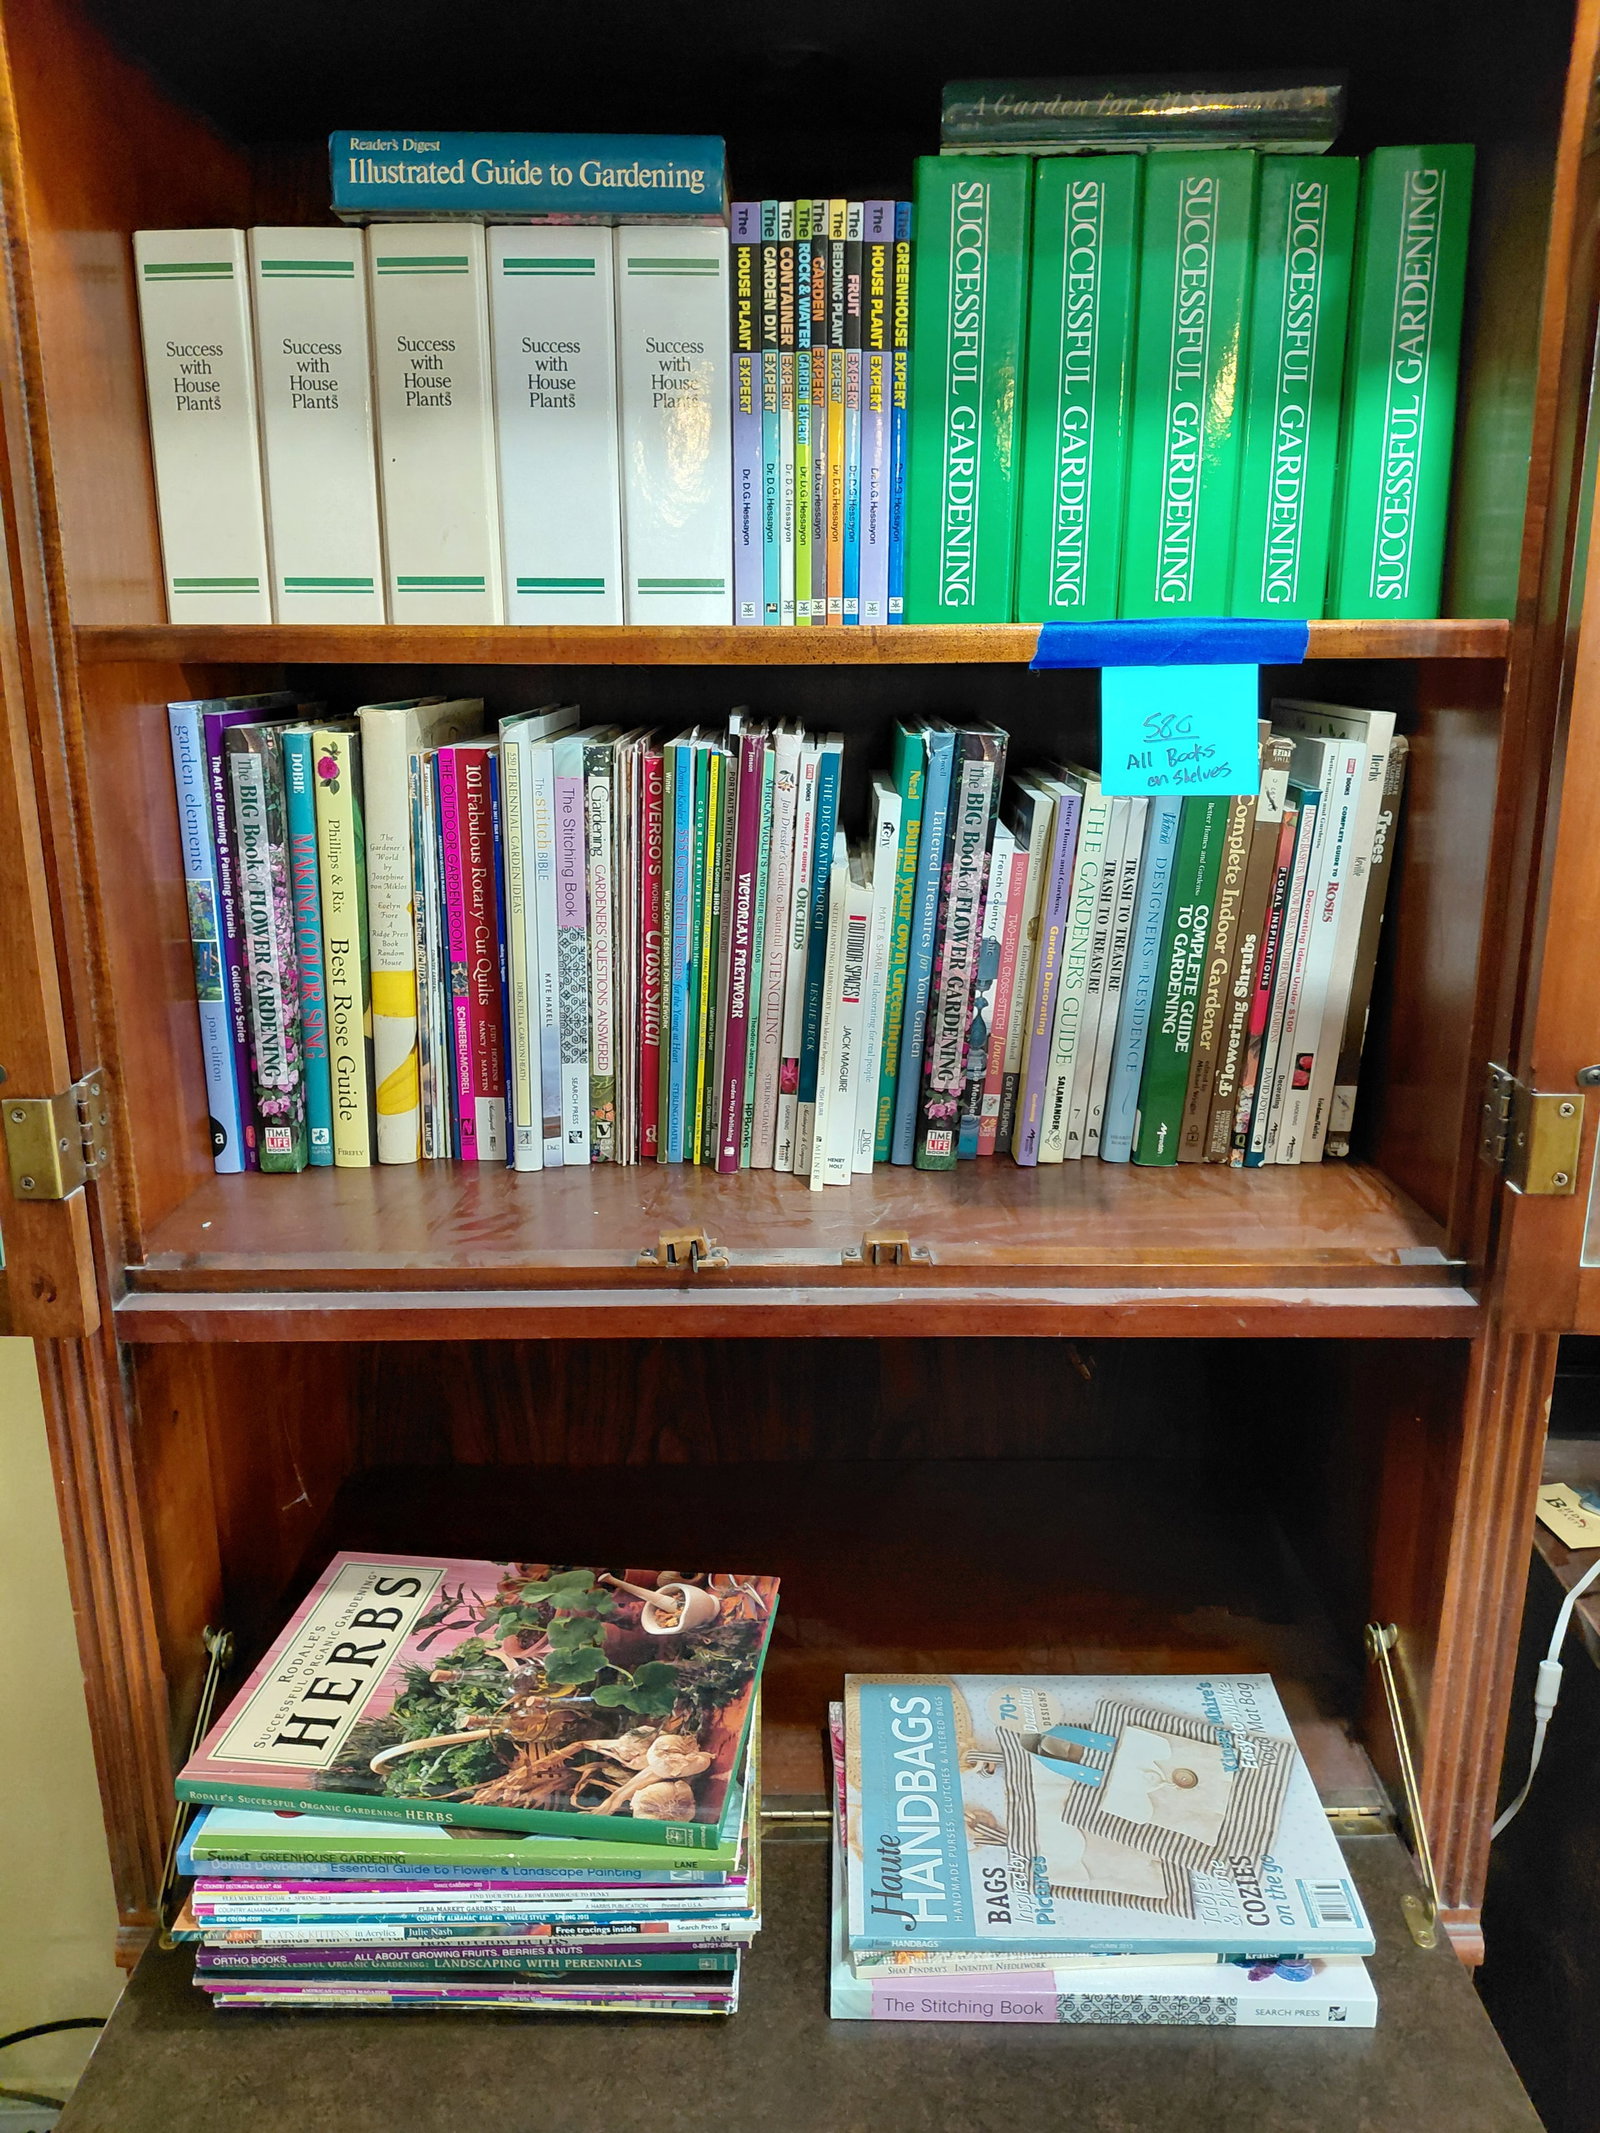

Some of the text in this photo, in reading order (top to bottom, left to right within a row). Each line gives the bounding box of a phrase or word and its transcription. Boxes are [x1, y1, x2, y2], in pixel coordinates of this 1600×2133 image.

[349, 158, 704, 194] Illustrated Guide to Gardening
[350, 138, 440, 153] Reader's Digest
[396, 336, 456, 352] Success
[522, 338, 581, 354] Success
[645, 338, 704, 354] Success
[738, 209, 751, 414] The HOUSE PLANT EXPERT
[764, 206, 776, 412] The GARDEN DIY EXPERT
[780, 209, 794, 412] The CONTAINER EXPERT
[798, 208, 811, 445] The ROCK & WATER GARDEN EXPERT
[812, 203, 825, 407] The GARDEN EXPERT
[832, 211, 844, 403] The BEDDING PLANT EXPERT
[848, 209, 860, 411] The FRUIT EXPERT
[870, 207, 884, 413] The HOUSE PLANT EXPERT
[894, 209, 910, 409] The GREENHOUSE EXPERT
[166, 342, 224, 357] Success
[173, 377, 221, 392] House
[180, 358, 212, 374] with
[282, 339, 342, 356] Success
[289, 376, 338, 391] House
[296, 357, 330, 373] with
[403, 374, 452, 388] House
[410, 354, 444, 371] with
[528, 374, 576, 390] House
[535, 355, 568, 372] with
[651, 375, 699, 390] House
[658, 356, 692, 372] with
[1375, 169, 1439, 600] SUCCESSFUL GARDENING
[943, 181, 983, 608] SUCCESSFUL GARDENING
[1054, 181, 1099, 608] SUCCESSFUL GARDENING
[1160, 176, 1213, 604] SUCCESSFUL GARDENING
[1265, 181, 1323, 604] SUCCESSFUL GARDENING
[175, 725, 205, 871] garden elements
[291, 753, 304, 793] DOBIE
[1127, 744, 1216, 770] All Books
[1148, 775, 1168, 787] on
[1368, 755, 1384, 782] Herbs
[328, 820, 344, 913] Phillips & Rix
[561, 787, 577, 917] The Stitching Book
[1371, 810, 1393, 864] Trees
[237, 759, 281, 1078] The BIG Book of FLOWER GARDENING
[466, 764, 493, 1005] 101 Fabulous Rotary-Cut Quilts
[1108, 858, 1137, 992] TRASH TO TREASURE
[1200, 795, 1255, 1050] Complete Indoor Gardener
[292, 834, 326, 1058] MAKING COLOR SING
[594, 864, 609, 1071] GARDENERS' QUESTIONS ANSWERED
[731, 873, 751, 1018] VICTORIAN FRETWORK
[842, 922, 866, 996] OUTDOOR SPACES
[1261, 867, 1287, 986] FLORAL INSPIRATIONS
[1161, 904, 1193, 1034] TO GARDENING
[1175, 904, 1209, 1053] COMPLETE GUIDE
[206, 1015, 223, 1082] joan clifton
[330, 938, 357, 1121] Best Rose Guide
[1216, 1001, 1246, 1097] Flowering
[1234, 934, 1256, 997] Shrubs
[838, 1026, 852, 1093] JACK MAGUIRE
[253, 1573, 377, 1749] SUCCESSFUL ORGANIC GARDENING
[271, 1576, 422, 1750] HERBS
[278, 1625, 326, 1683] RODALE'S
[1000, 1694, 1018, 1720] 70+
[891, 1696, 948, 1923] HANDBAGS
[871, 1835, 917, 1931] Haute
[982, 1867, 1011, 1924] BAGS
[1229, 1856, 1270, 1927] COZIES
[213, 1955, 287, 1965] ORTHO BOOKS
[355, 1953, 372, 1961] ALL
[375, 1952, 409, 1960] ABOUT
[412, 1951, 459, 1960] GROWING
[498, 1947, 545, 1956] BERRIES
[548, 1947, 554, 1955] &
[556, 1947, 583, 1955] NUTS
[884, 1997, 1044, 2016] The Stitching Book
[1256, 2008, 1320, 2017] SEARCH PRESS
